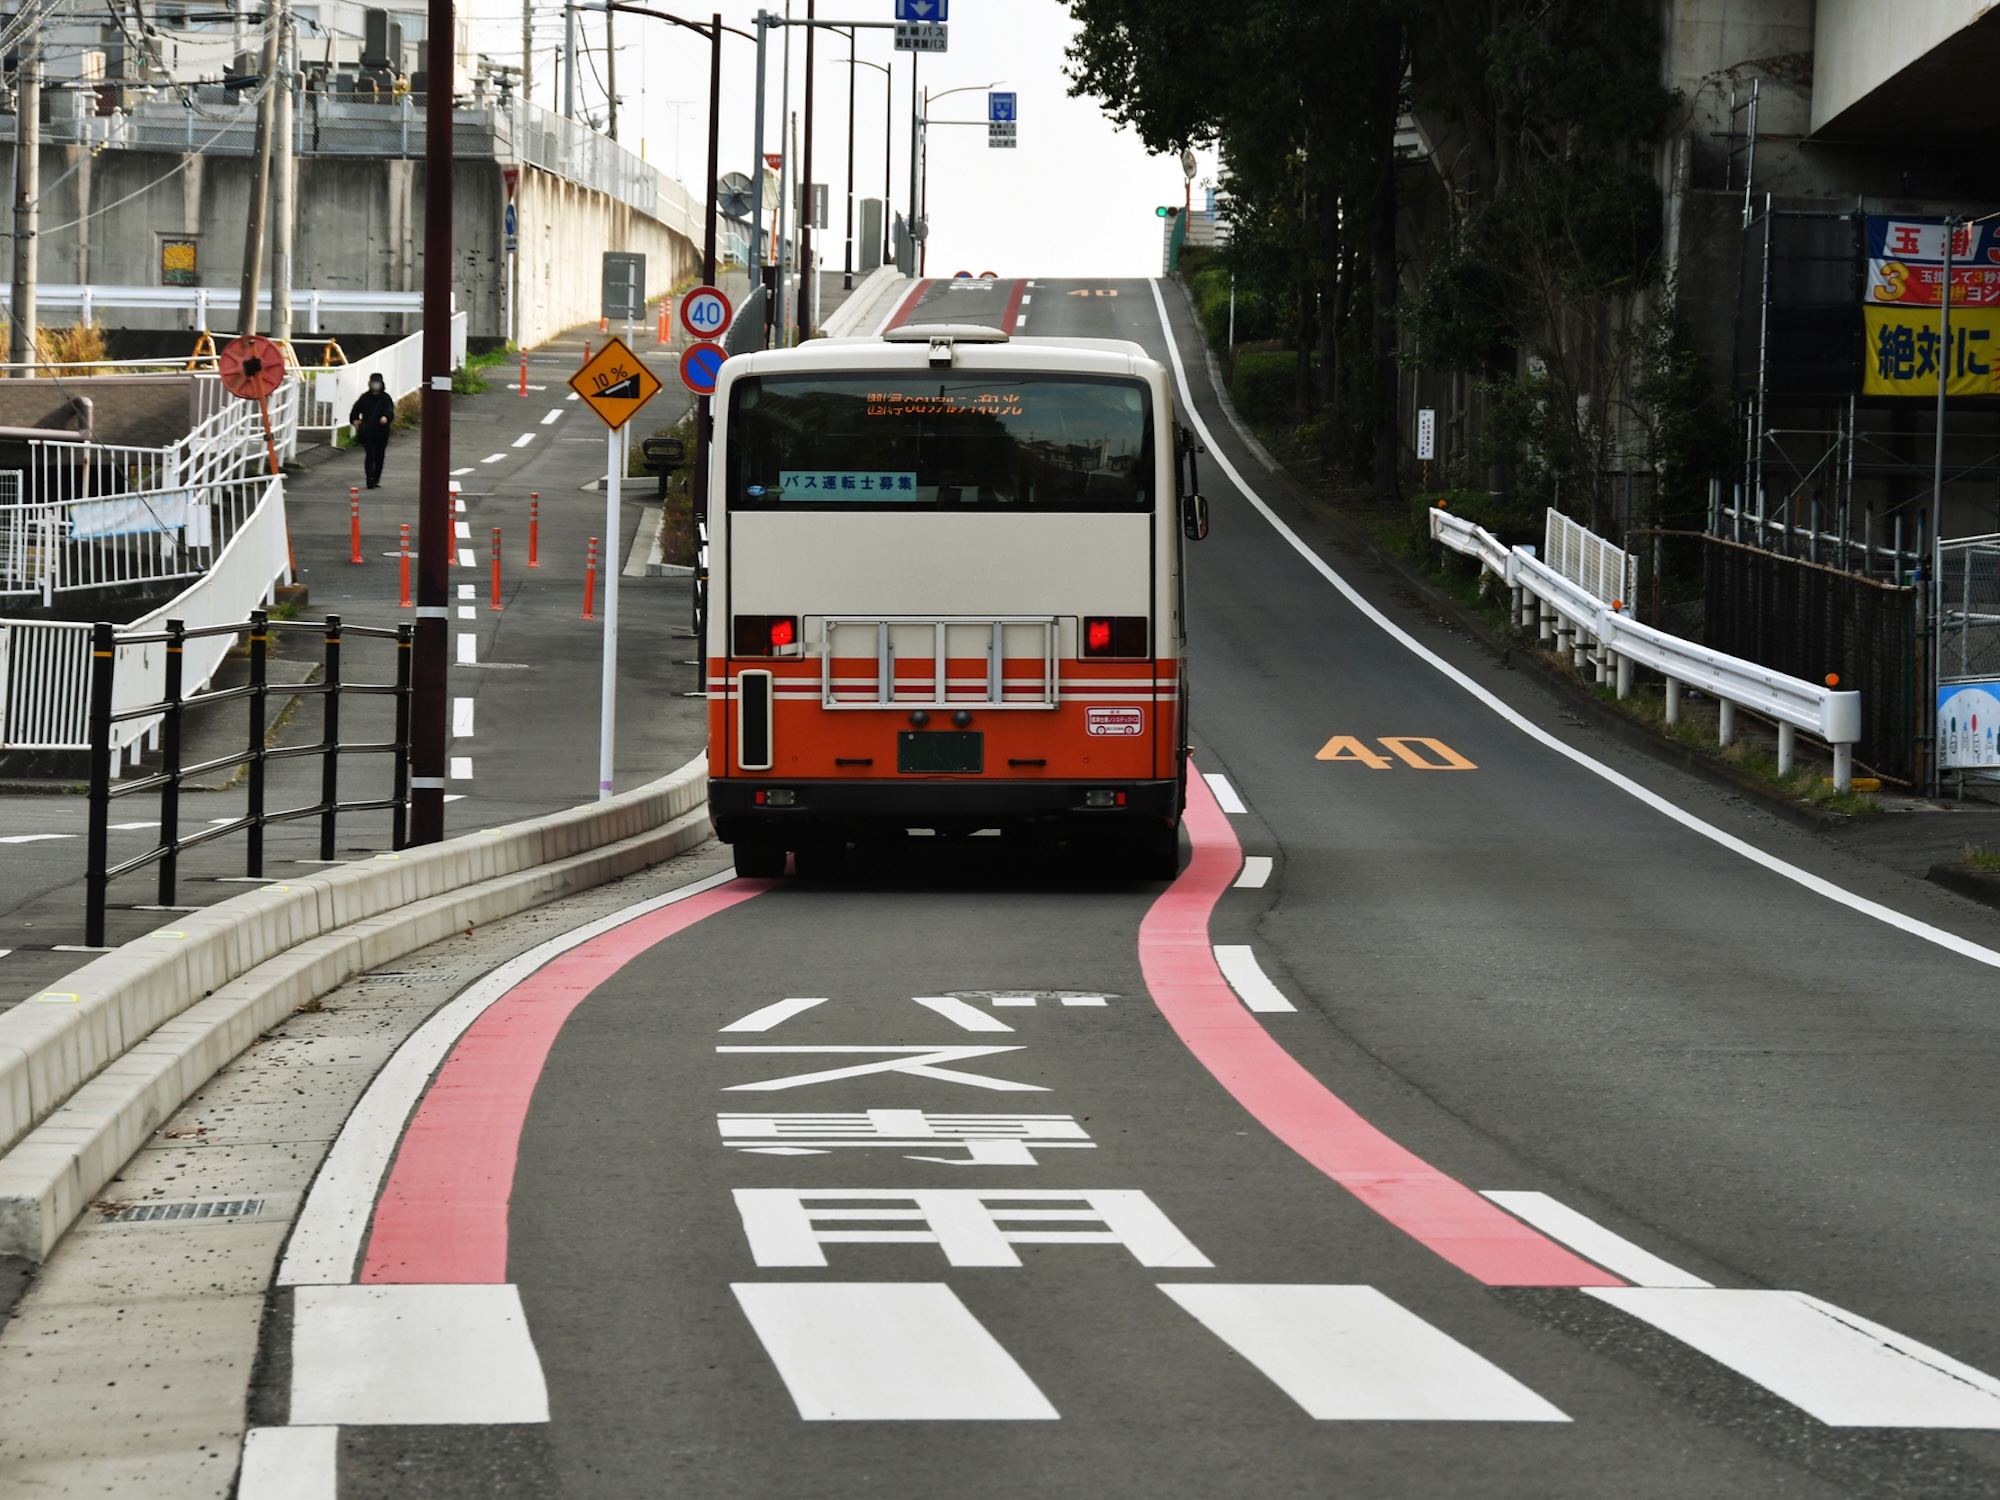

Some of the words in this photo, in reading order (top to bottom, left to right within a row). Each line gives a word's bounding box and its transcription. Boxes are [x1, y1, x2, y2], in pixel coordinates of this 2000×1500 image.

[897, 26, 945, 37] 路線バス
[896, 38, 946, 49] 実証実験バス
[1874, 262, 1910, 301] 3
[1920, 270, 2000, 284] 玉掛して3秒
[1067, 289, 1118, 297] 40
[692, 302, 721, 325] 40
[1878, 324, 1990, 380] 絶対に
[784, 475, 912, 491] バス運転士募集
[1315, 735, 1479, 770] 40
